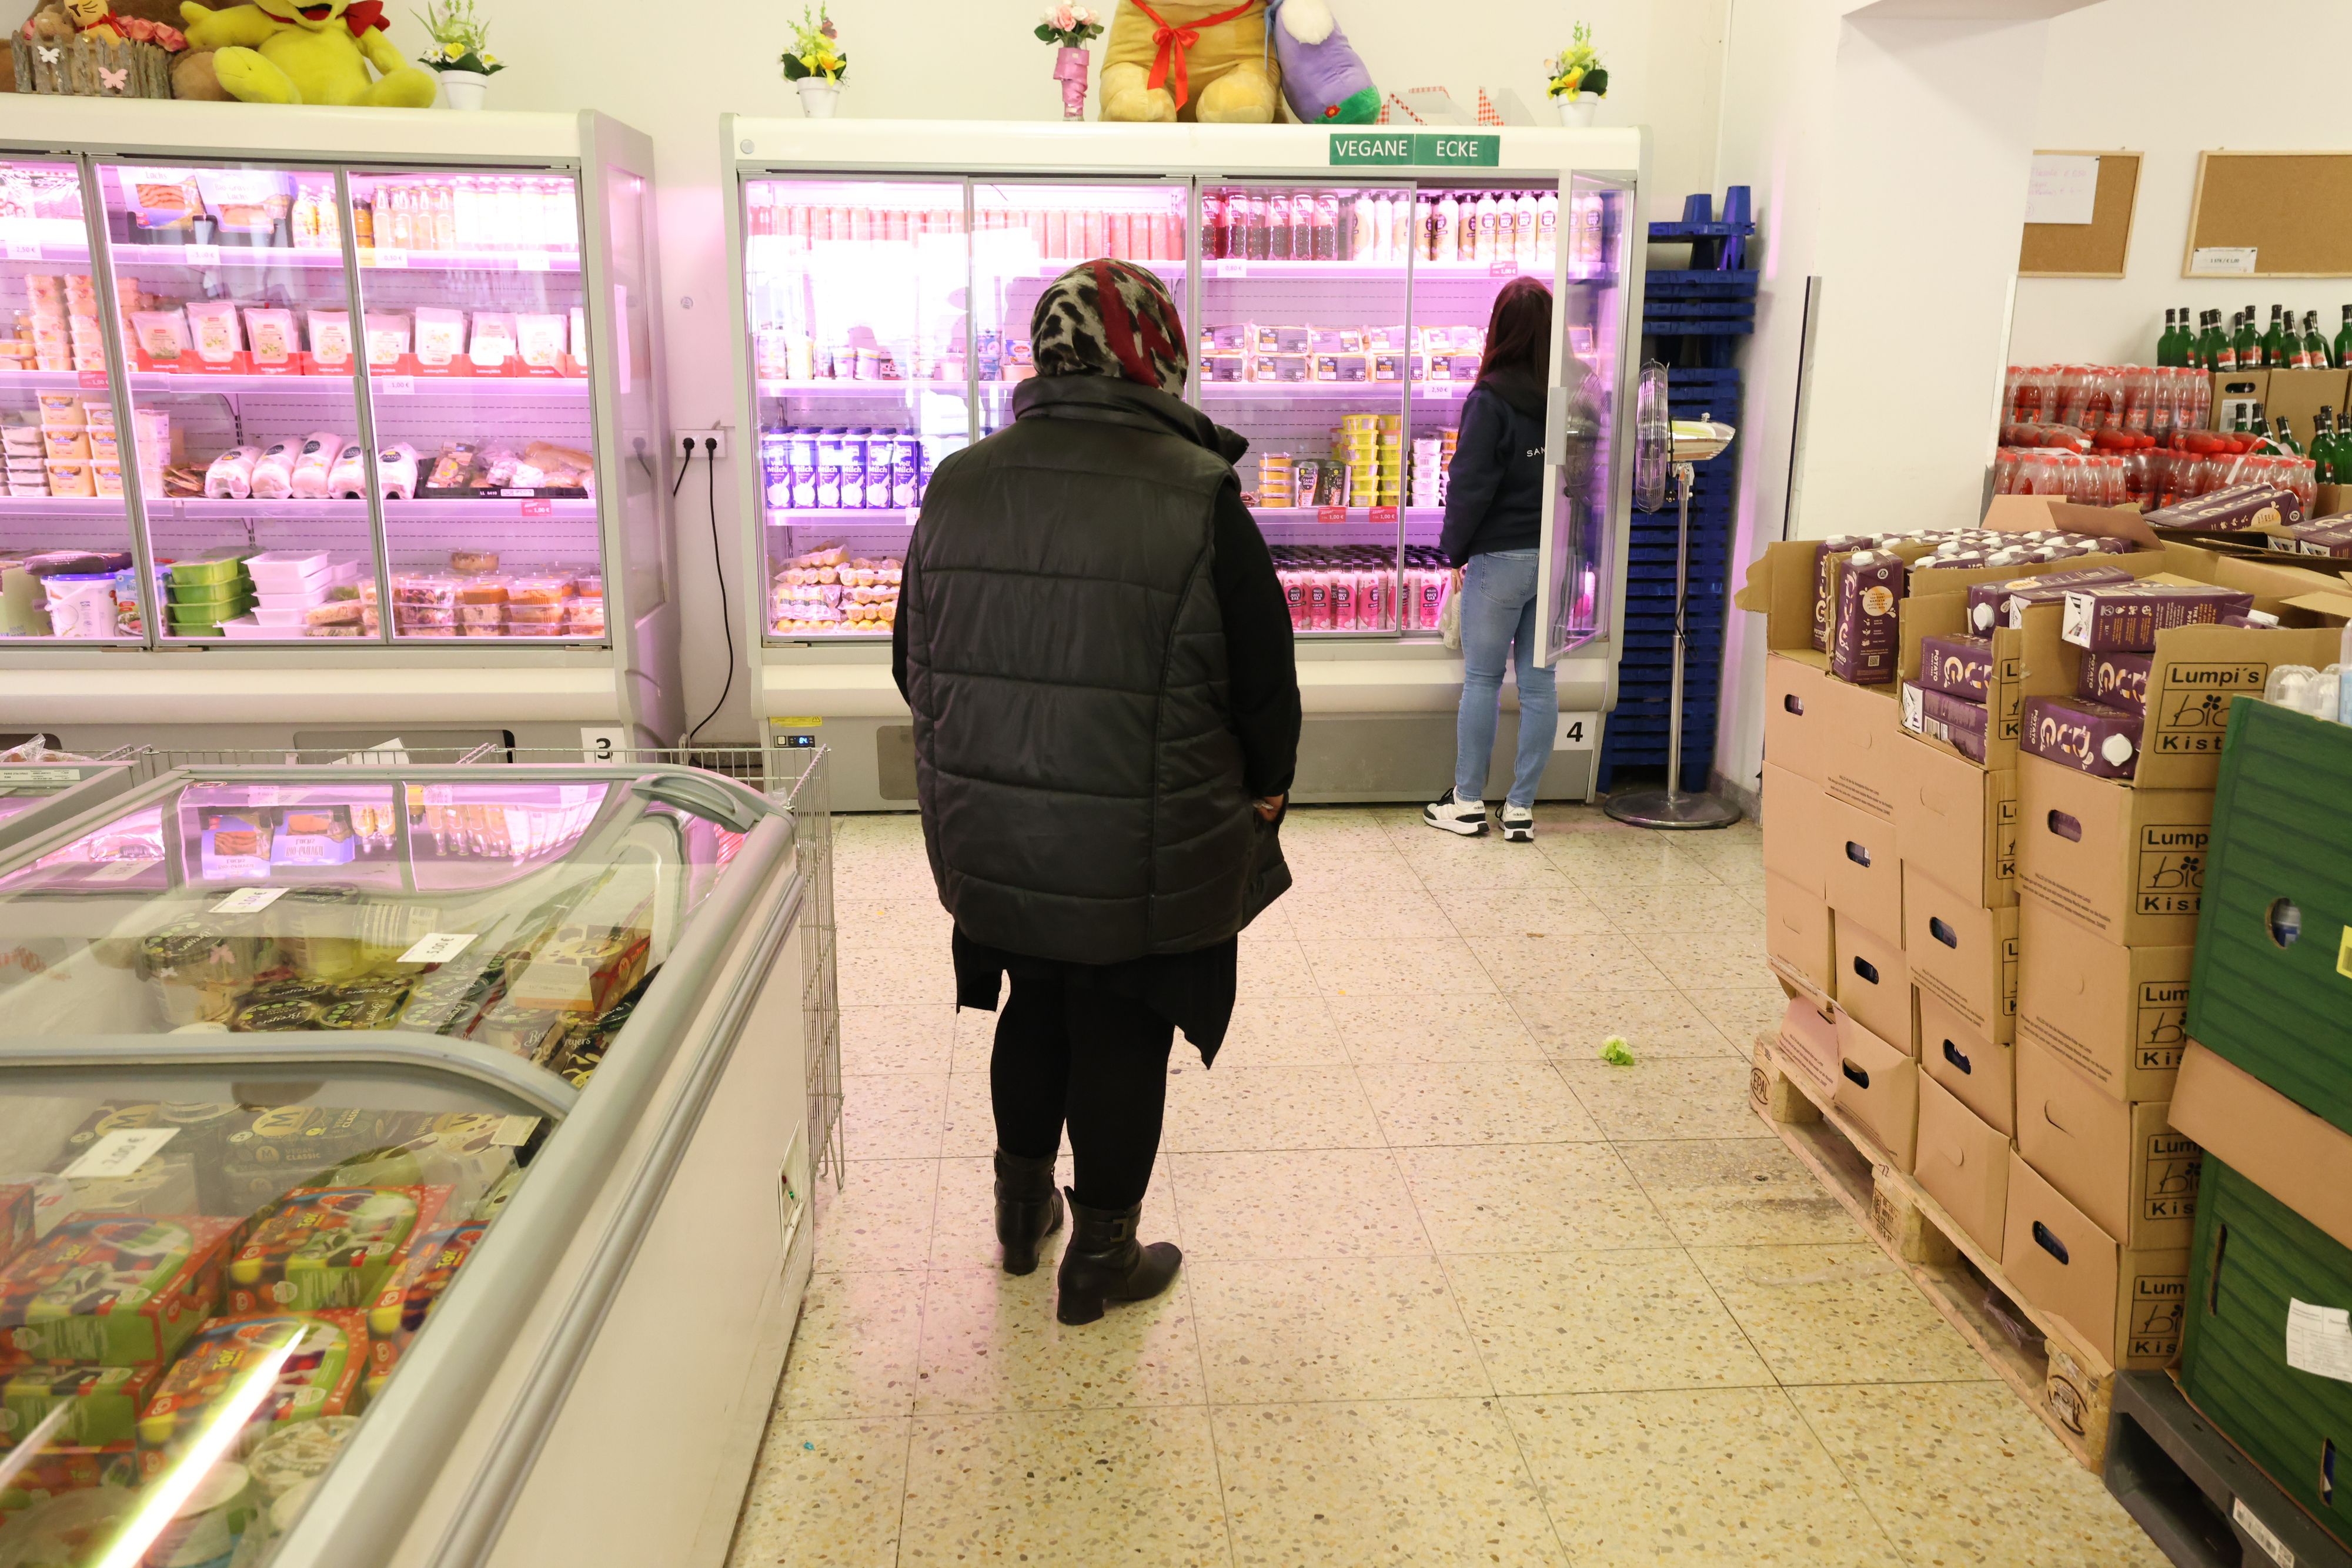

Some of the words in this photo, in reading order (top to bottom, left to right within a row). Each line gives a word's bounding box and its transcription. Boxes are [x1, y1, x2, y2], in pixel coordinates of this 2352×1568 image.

[1336, 141, 1408, 157] VEGANE
[1436, 141, 1478, 157] ECKE
[1566, 721, 1583, 742] 4
[596, 738, 613, 759] 3
[2163, 737, 2221, 750] Kist
[2147, 830, 2209, 849] Lump
[178, 928, 213, 952] Breyers
[427, 942, 450, 954] 5,00
[2146, 988, 2190, 1002] Lum
[256, 1009, 306, 1024] Breyers
[524, 1029, 552, 1046] Brey
[1753, 1072, 1768, 1101] EPAL
[2154, 1138, 2203, 1155] Lum
[286, 1153, 321, 1161] CLASSIC
[2152, 1202, 2194, 1216] Kis
[2140, 1281, 2184, 1295] Lum
[2134, 1340, 2176, 1353] Kis
